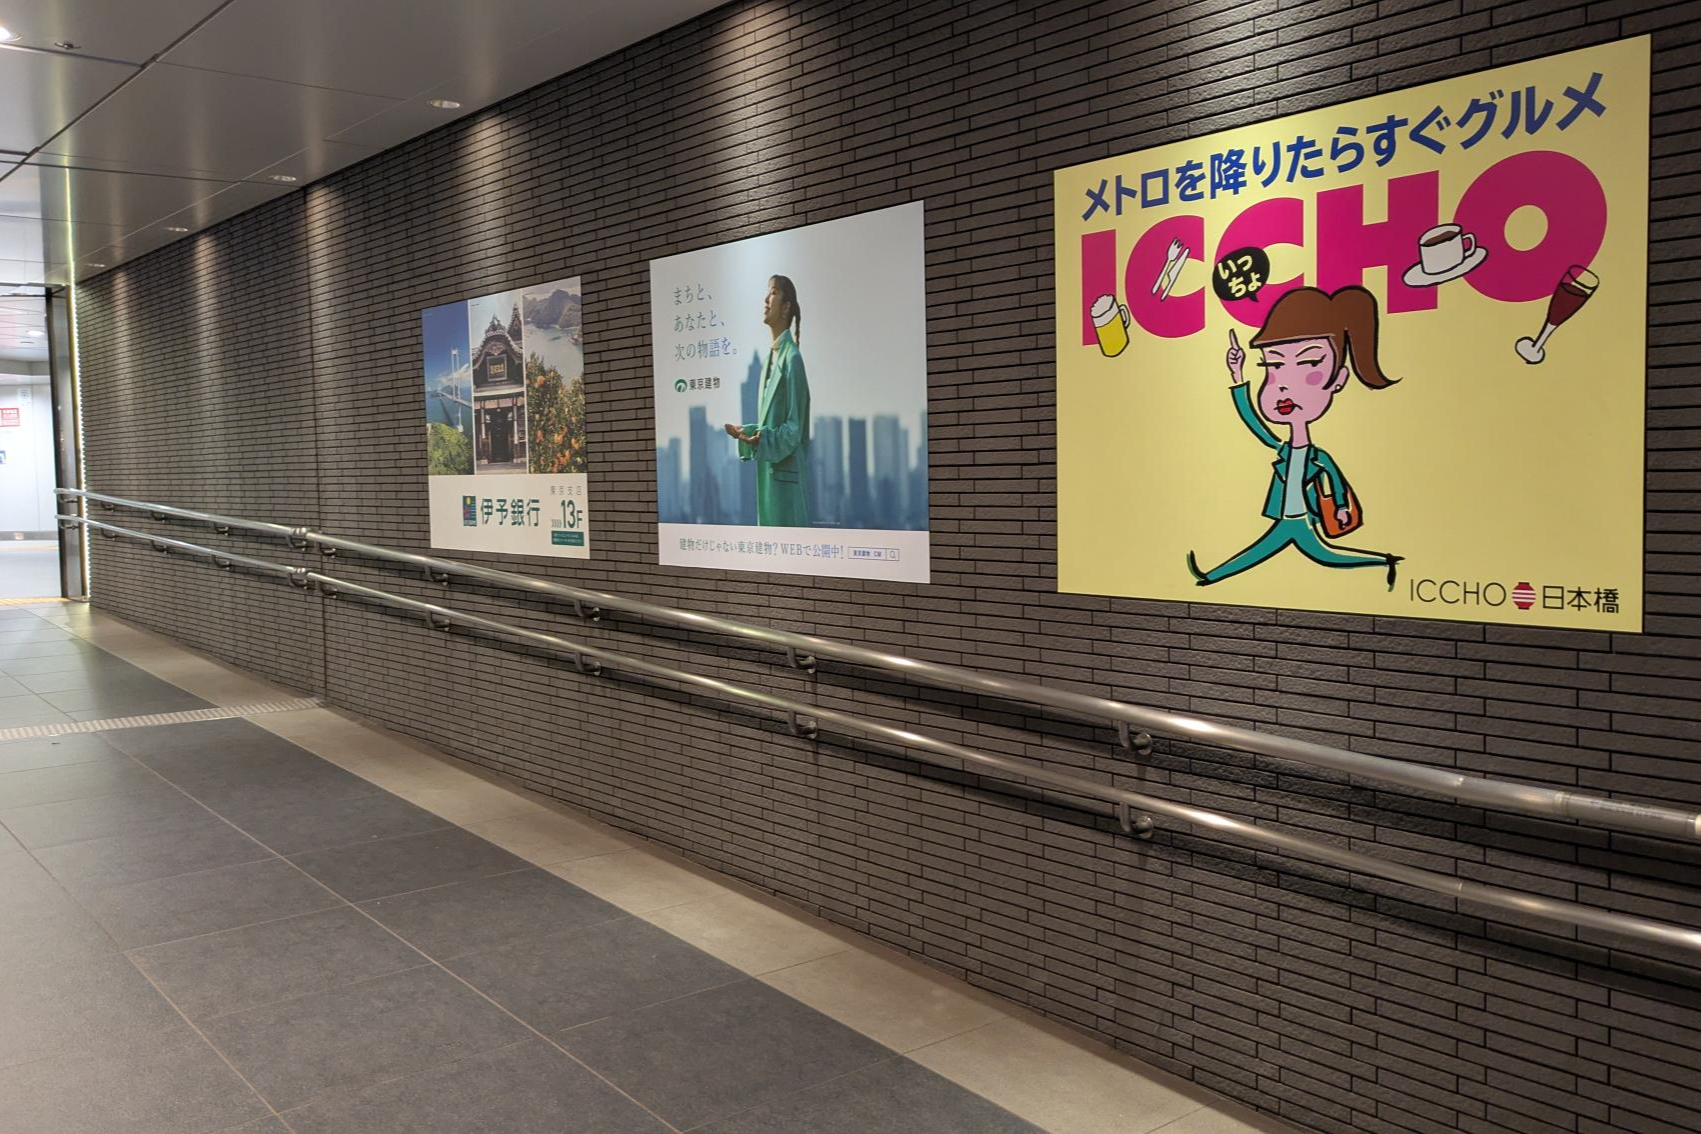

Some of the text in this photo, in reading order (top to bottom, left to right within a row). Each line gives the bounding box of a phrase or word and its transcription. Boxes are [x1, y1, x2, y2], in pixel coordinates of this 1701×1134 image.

[1081, 71, 1607, 221] メトロを降りたらすぐグルメ
[1080, 149, 1608, 346] ICCHO
[673, 283, 712, 306] まちと、
[674, 309, 725, 333] あなたと、
[674, 337, 738, 361] 次の物語を。
[688, 376, 721, 391] 東京建物
[480, 498, 541, 527] 伊予銀行
[560, 499, 584, 529] 13F
[1410, 578, 1507, 607] ICCHO
[1542, 585, 1620, 614] 日本橋
